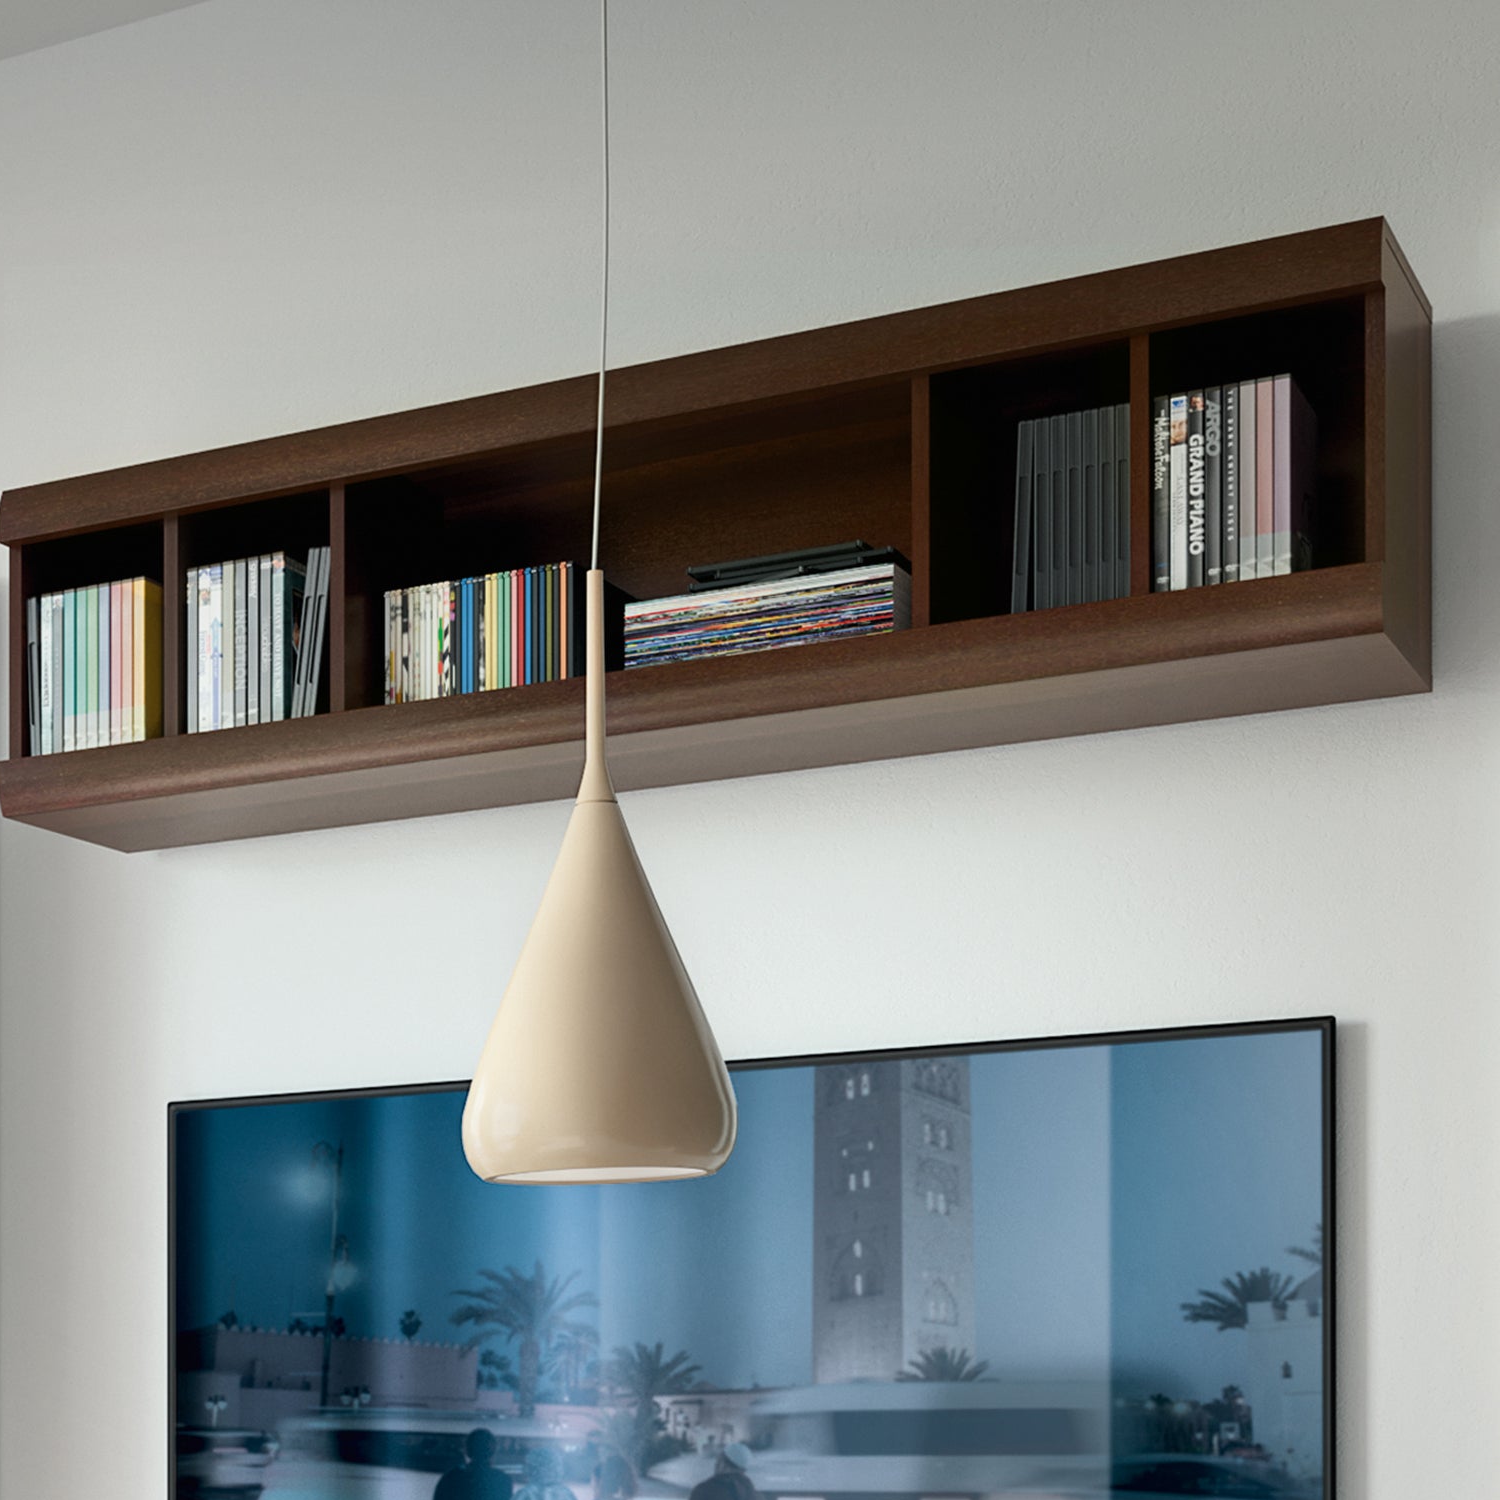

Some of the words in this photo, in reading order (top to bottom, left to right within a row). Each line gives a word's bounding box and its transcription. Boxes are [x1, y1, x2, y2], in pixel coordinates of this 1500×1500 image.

[1227, 390, 1235, 411] THE
[1206, 400, 1221, 457] ARGO
[1227, 418, 1235, 448] DARK
[1189, 433, 1205, 496] GRAND
[1227, 455, 1235, 497] KNIGHT
[1189, 499, 1205, 556] PIANO
[1227, 504, 1235, 542] RISES
[235, 609, 245, 691] INCEPTION
